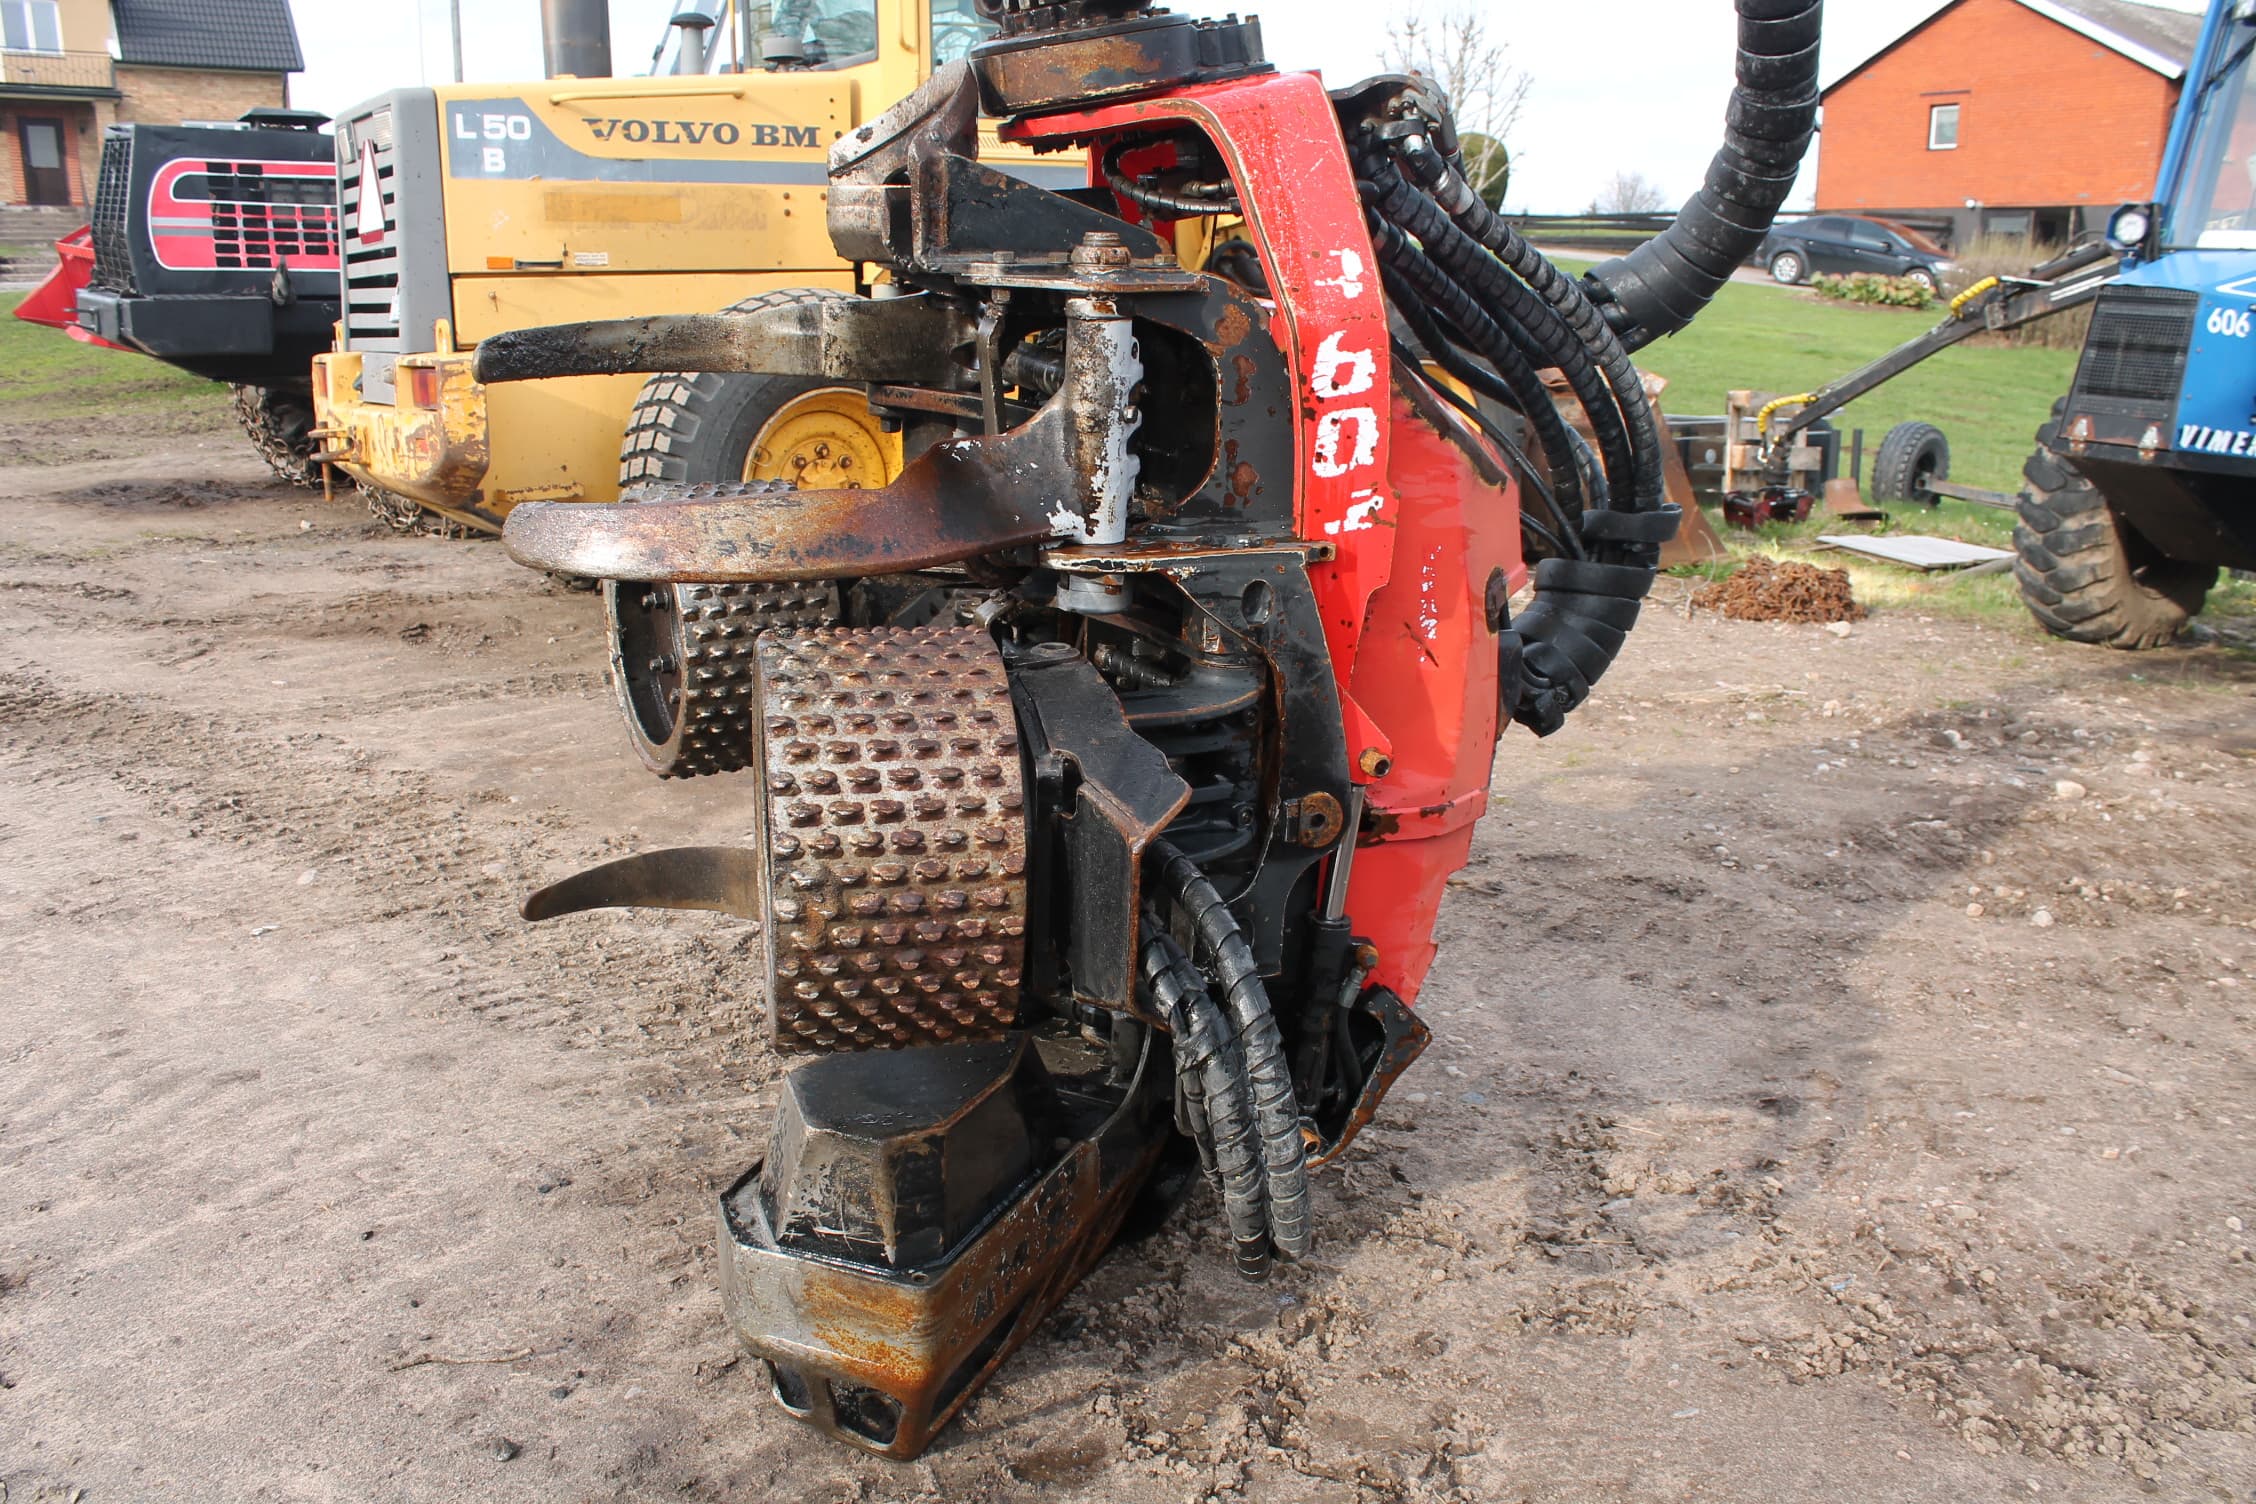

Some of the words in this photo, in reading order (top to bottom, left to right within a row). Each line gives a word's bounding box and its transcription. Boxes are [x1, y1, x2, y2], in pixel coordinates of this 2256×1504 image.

[582, 118, 740, 145] VOLVO
[751, 123, 821, 148] BM
[482, 147, 506, 172] B
[2206, 307, 2251, 338] 606
